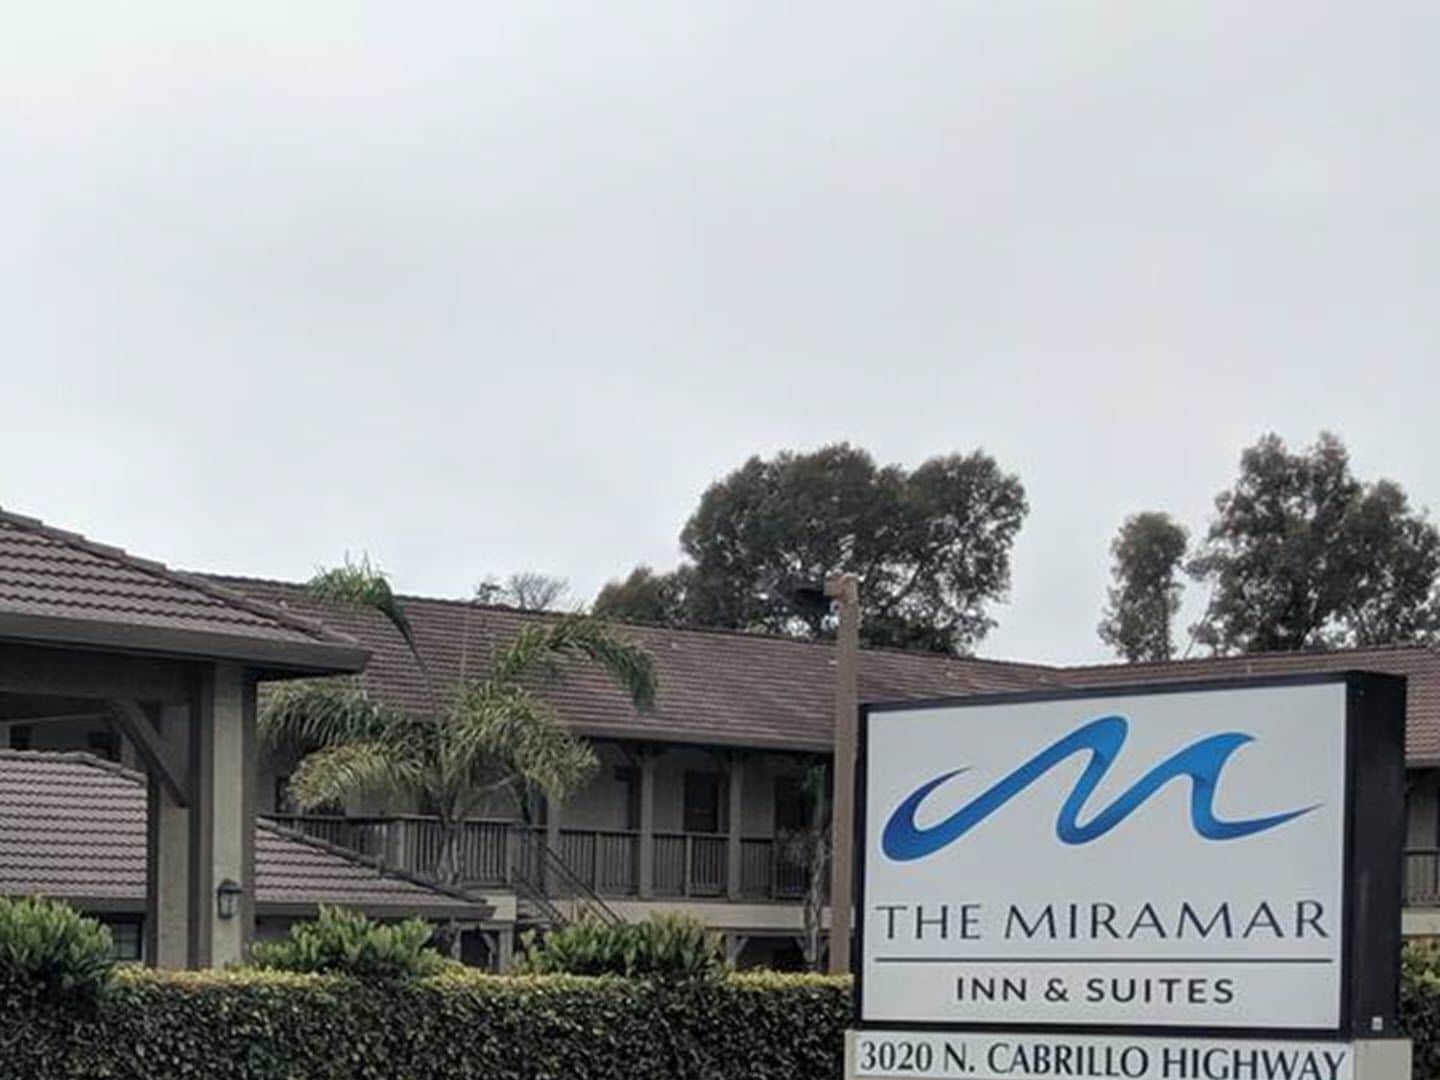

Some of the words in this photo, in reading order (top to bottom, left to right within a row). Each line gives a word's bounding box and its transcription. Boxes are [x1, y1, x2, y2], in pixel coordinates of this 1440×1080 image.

[874, 903, 982, 941] THE
[1004, 899, 1330, 941] MIRAMAR
[956, 976, 1028, 1002] INN
[1043, 976, 1071, 1003] &
[1085, 976, 1235, 1006] SUITES
[860, 1040, 935, 1073] 3020
[943, 1042, 976, 1074] N.
[987, 1042, 1150, 1080] CABRILLO
